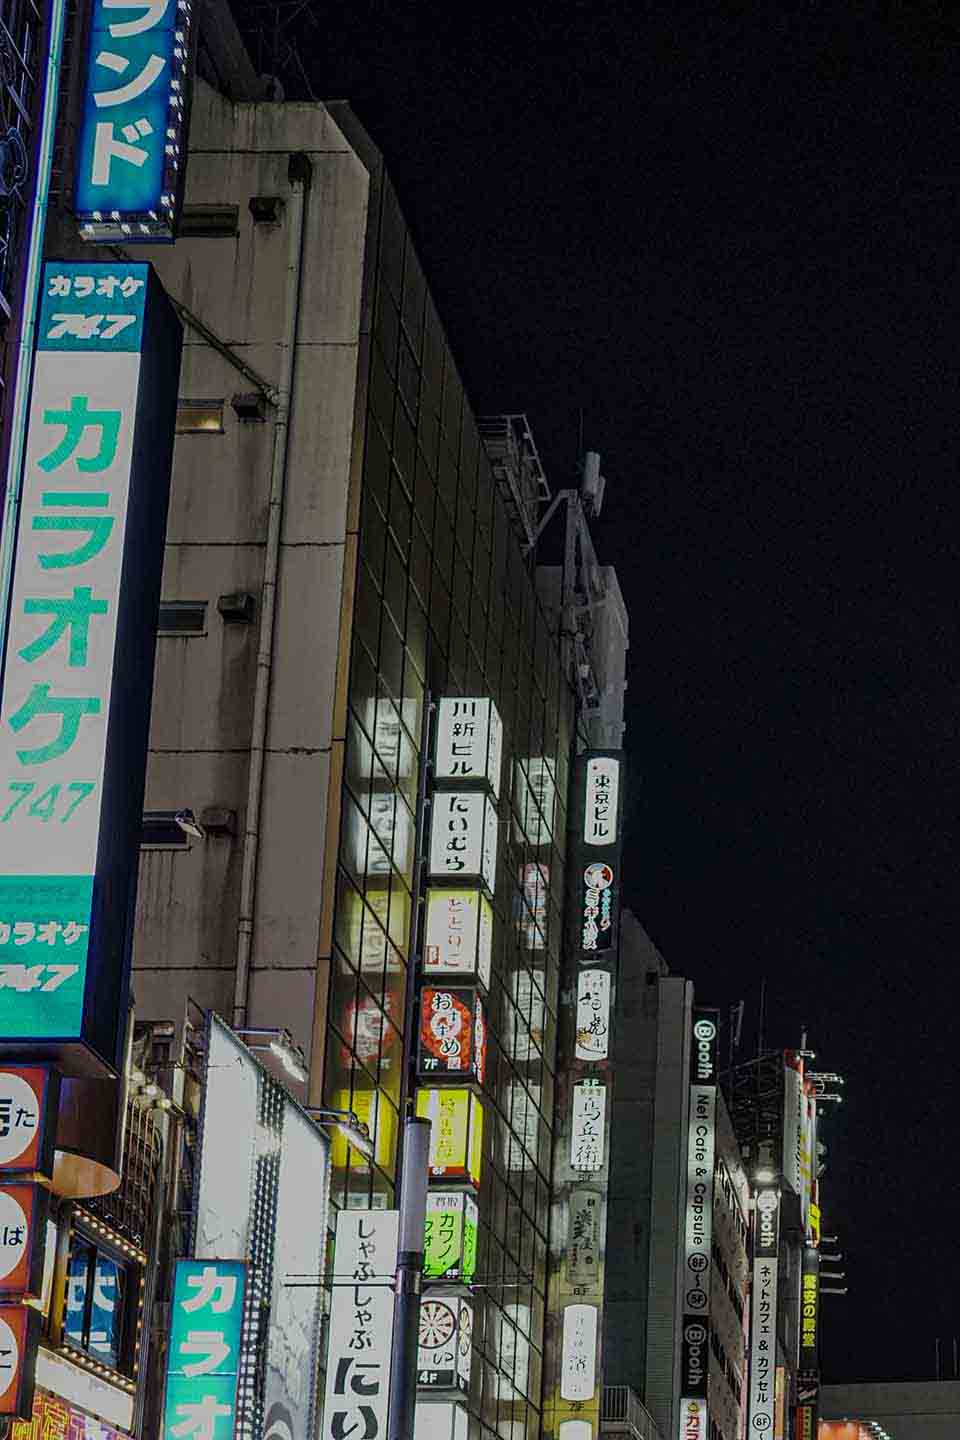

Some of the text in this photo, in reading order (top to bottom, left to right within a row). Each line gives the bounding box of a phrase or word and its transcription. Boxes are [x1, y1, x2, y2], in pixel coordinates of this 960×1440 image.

[48, 276, 143, 299] カラオケ
[8, 395, 122, 766] カラオケ
[449, 702, 476, 775] 川新ビル
[0, 783, 96, 824] 747
[593, 776, 610, 837] 東京ビル
[423, 1058, 439, 1070] 7F
[694, 1020, 716, 1079] Booth
[349, 1218, 376, 1350] しゃぶしゃぶ
[759, 1266, 771, 1334] ネットカフェ
[758, 1340, 769, 1352] &
[420, 1370, 438, 1384] 4F
